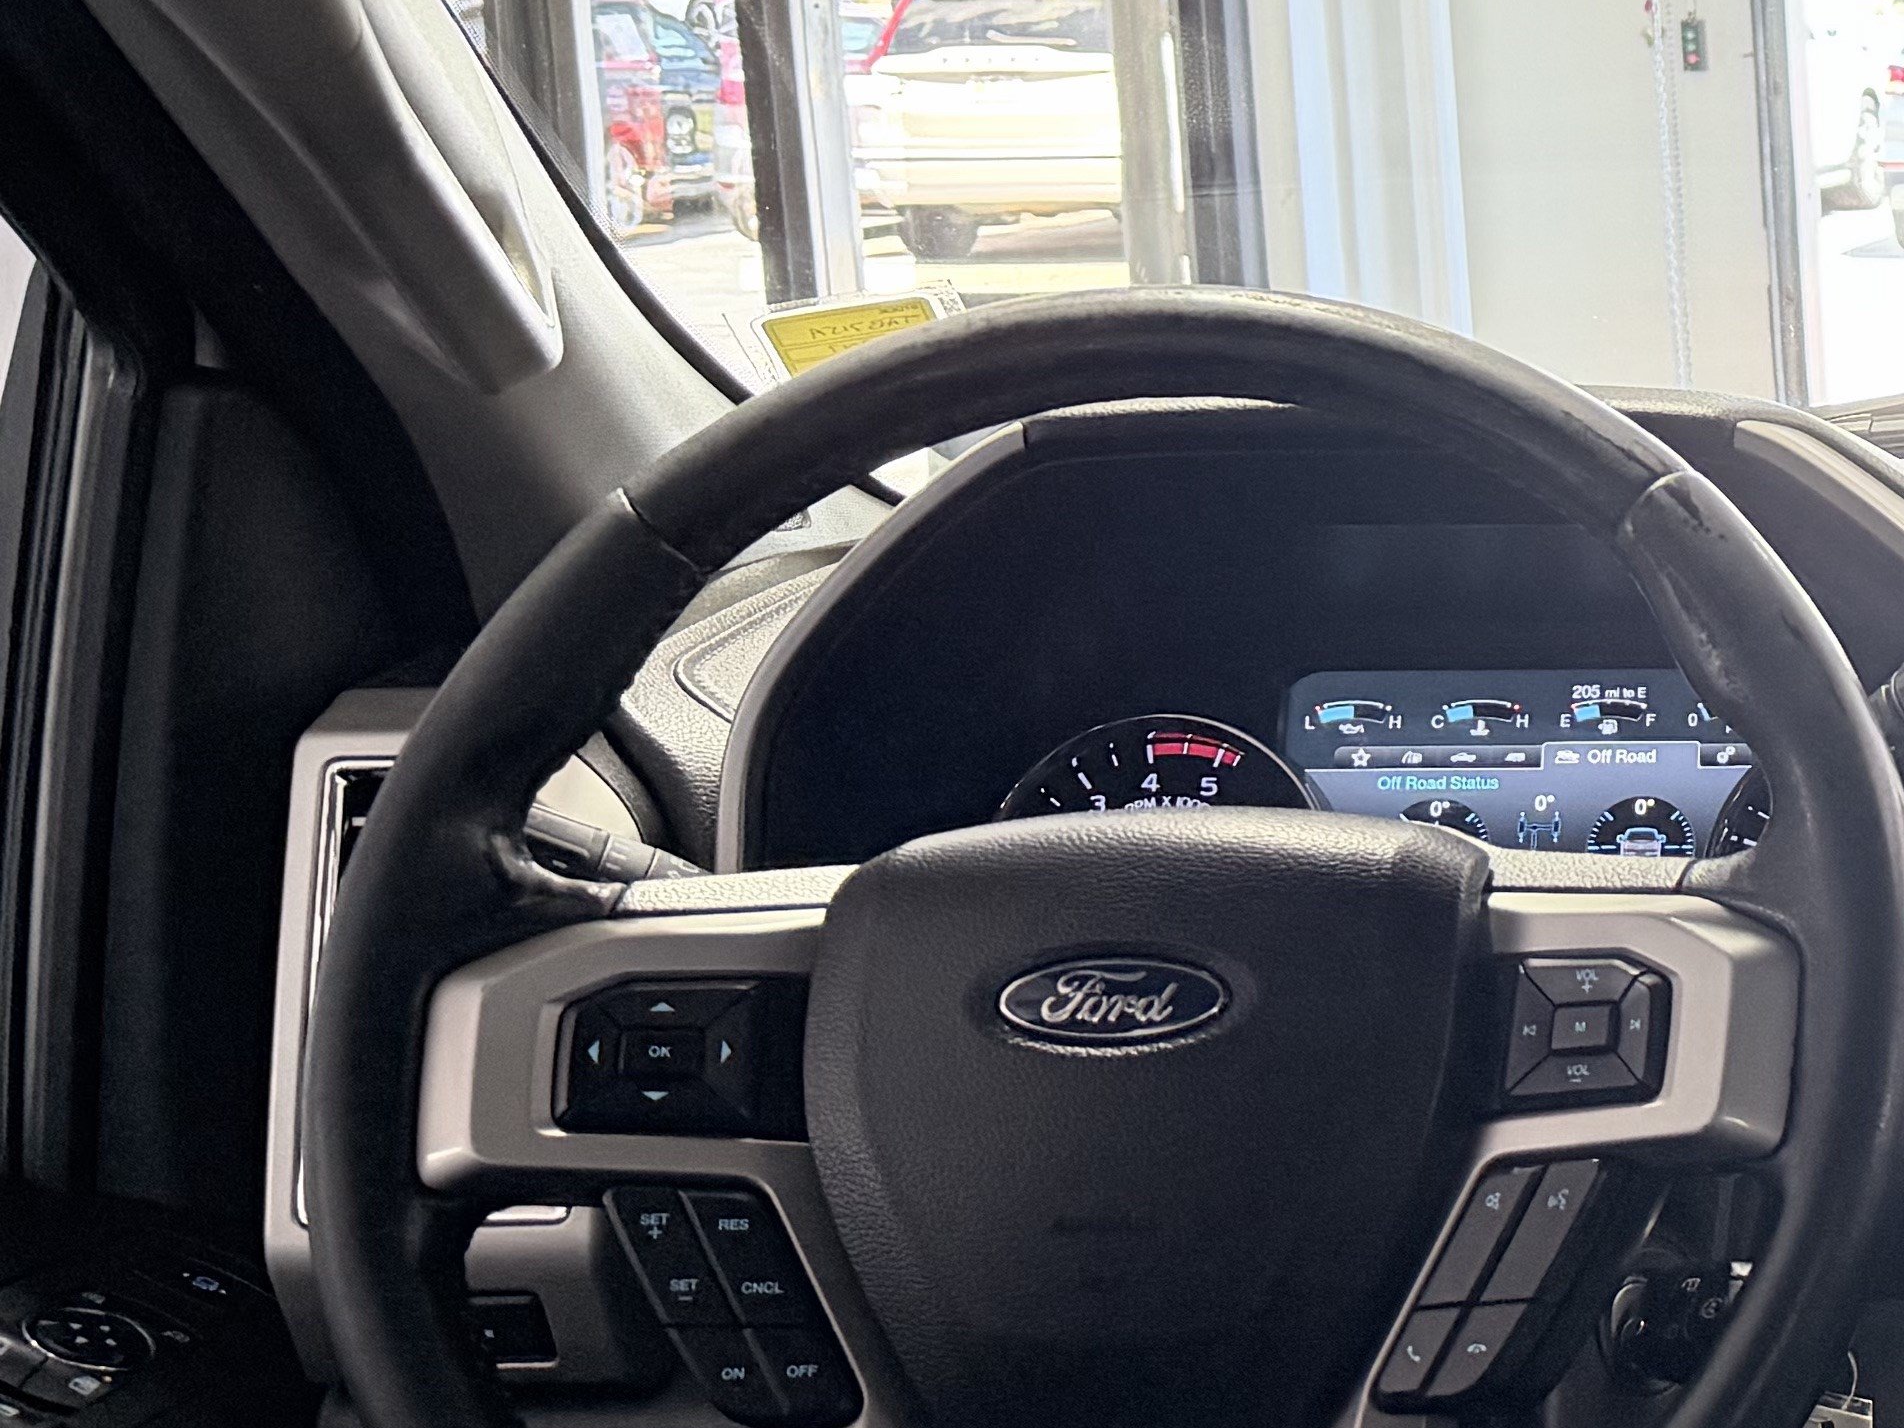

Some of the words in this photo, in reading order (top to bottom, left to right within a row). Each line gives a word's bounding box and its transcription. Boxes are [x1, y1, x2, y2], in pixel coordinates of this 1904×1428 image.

[1572, 685, 1600, 699] 205
[1623, 687, 1635, 698] to
[1638, 687, 1647, 698] E
[1305, 716, 1315, 730] L
[1389, 715, 1402, 729] H
[1431, 715, 1444, 729] C
[1516, 715, 1529, 727] H
[1560, 715, 1571, 728] E
[1646, 714, 1656, 726] F
[1587, 748, 1613, 764] Off
[1615, 749, 1657, 764] Road
[1141, 774, 1160, 792] 4
[1200, 777, 1218, 796] 5
[1377, 775, 1402, 791] Off
[1405, 775, 1446, 791] Road
[1450, 775, 1499, 790] Status
[1090, 795, 1106, 812] 3
[1575, 968, 1599, 981] VOL
[1040, 972, 1178, 1027] Ford
[649, 1045, 671, 1059] OK
[640, 1212, 669, 1227] SET
[718, 1217, 749, 1232] RES
[670, 1278, 699, 1292] SET
[741, 1281, 784, 1295] CNCL
[721, 1367, 745, 1381] ON
[786, 1364, 818, 1378] OFF
